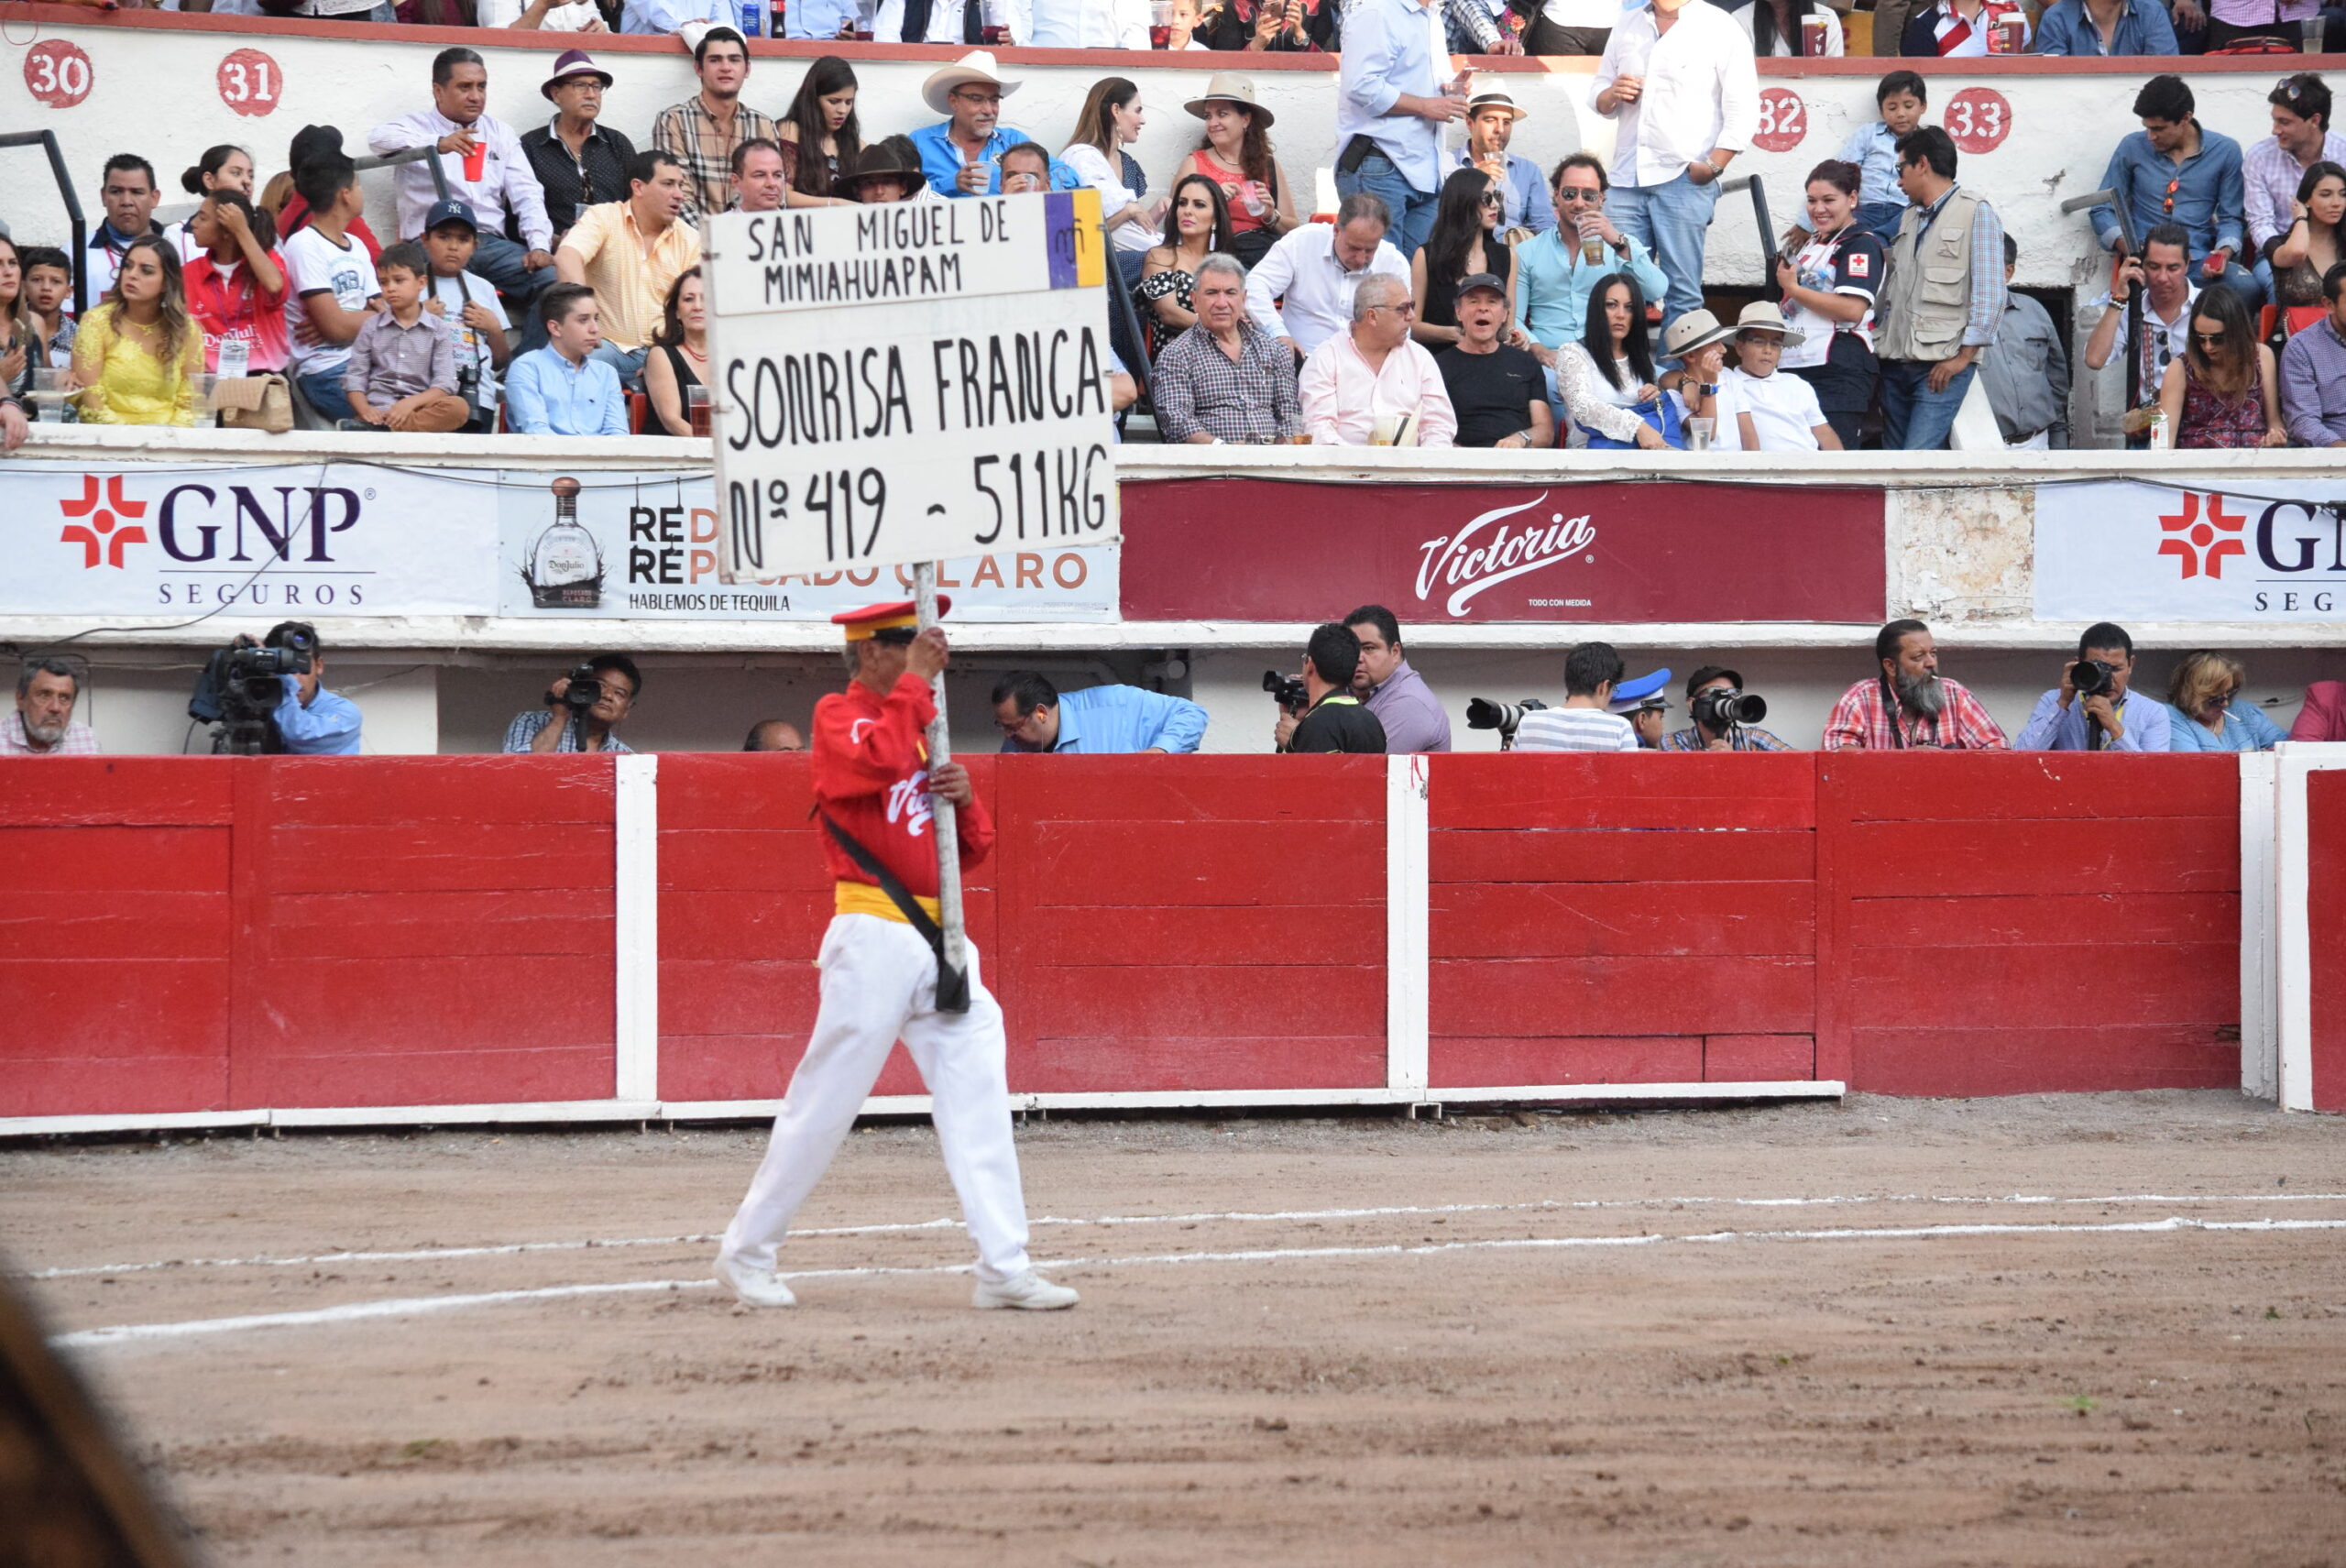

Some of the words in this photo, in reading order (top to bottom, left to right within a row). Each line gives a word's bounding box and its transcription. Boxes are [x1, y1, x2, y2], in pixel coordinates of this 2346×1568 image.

[32, 55, 90, 95] 30
[225, 62, 272, 102] 31
[1948, 102, 2001, 138] 33
[747, 215, 814, 262] SAN
[857, 203, 966, 253] MIGUEL
[981, 200, 1010, 243] DE
[763, 253, 963, 305] MIMIAHUAPAM
[727, 345, 913, 451] SONRISA
[932, 326, 1105, 432] FRANCA
[159, 484, 361, 562] GNP
[804, 467, 887, 562] 419
[1415, 489, 1596, 618] Victoria
[159, 583, 364, 606] SEGUROS
[630, 594, 706, 611] HABLEMOS
[709, 595, 729, 610] DE
[730, 595, 791, 612] TEQUILA
[1528, 598, 1548, 607] TODO
[1549, 598, 1564, 607] CON
[1565, 598, 1592, 607] MEDIDA
